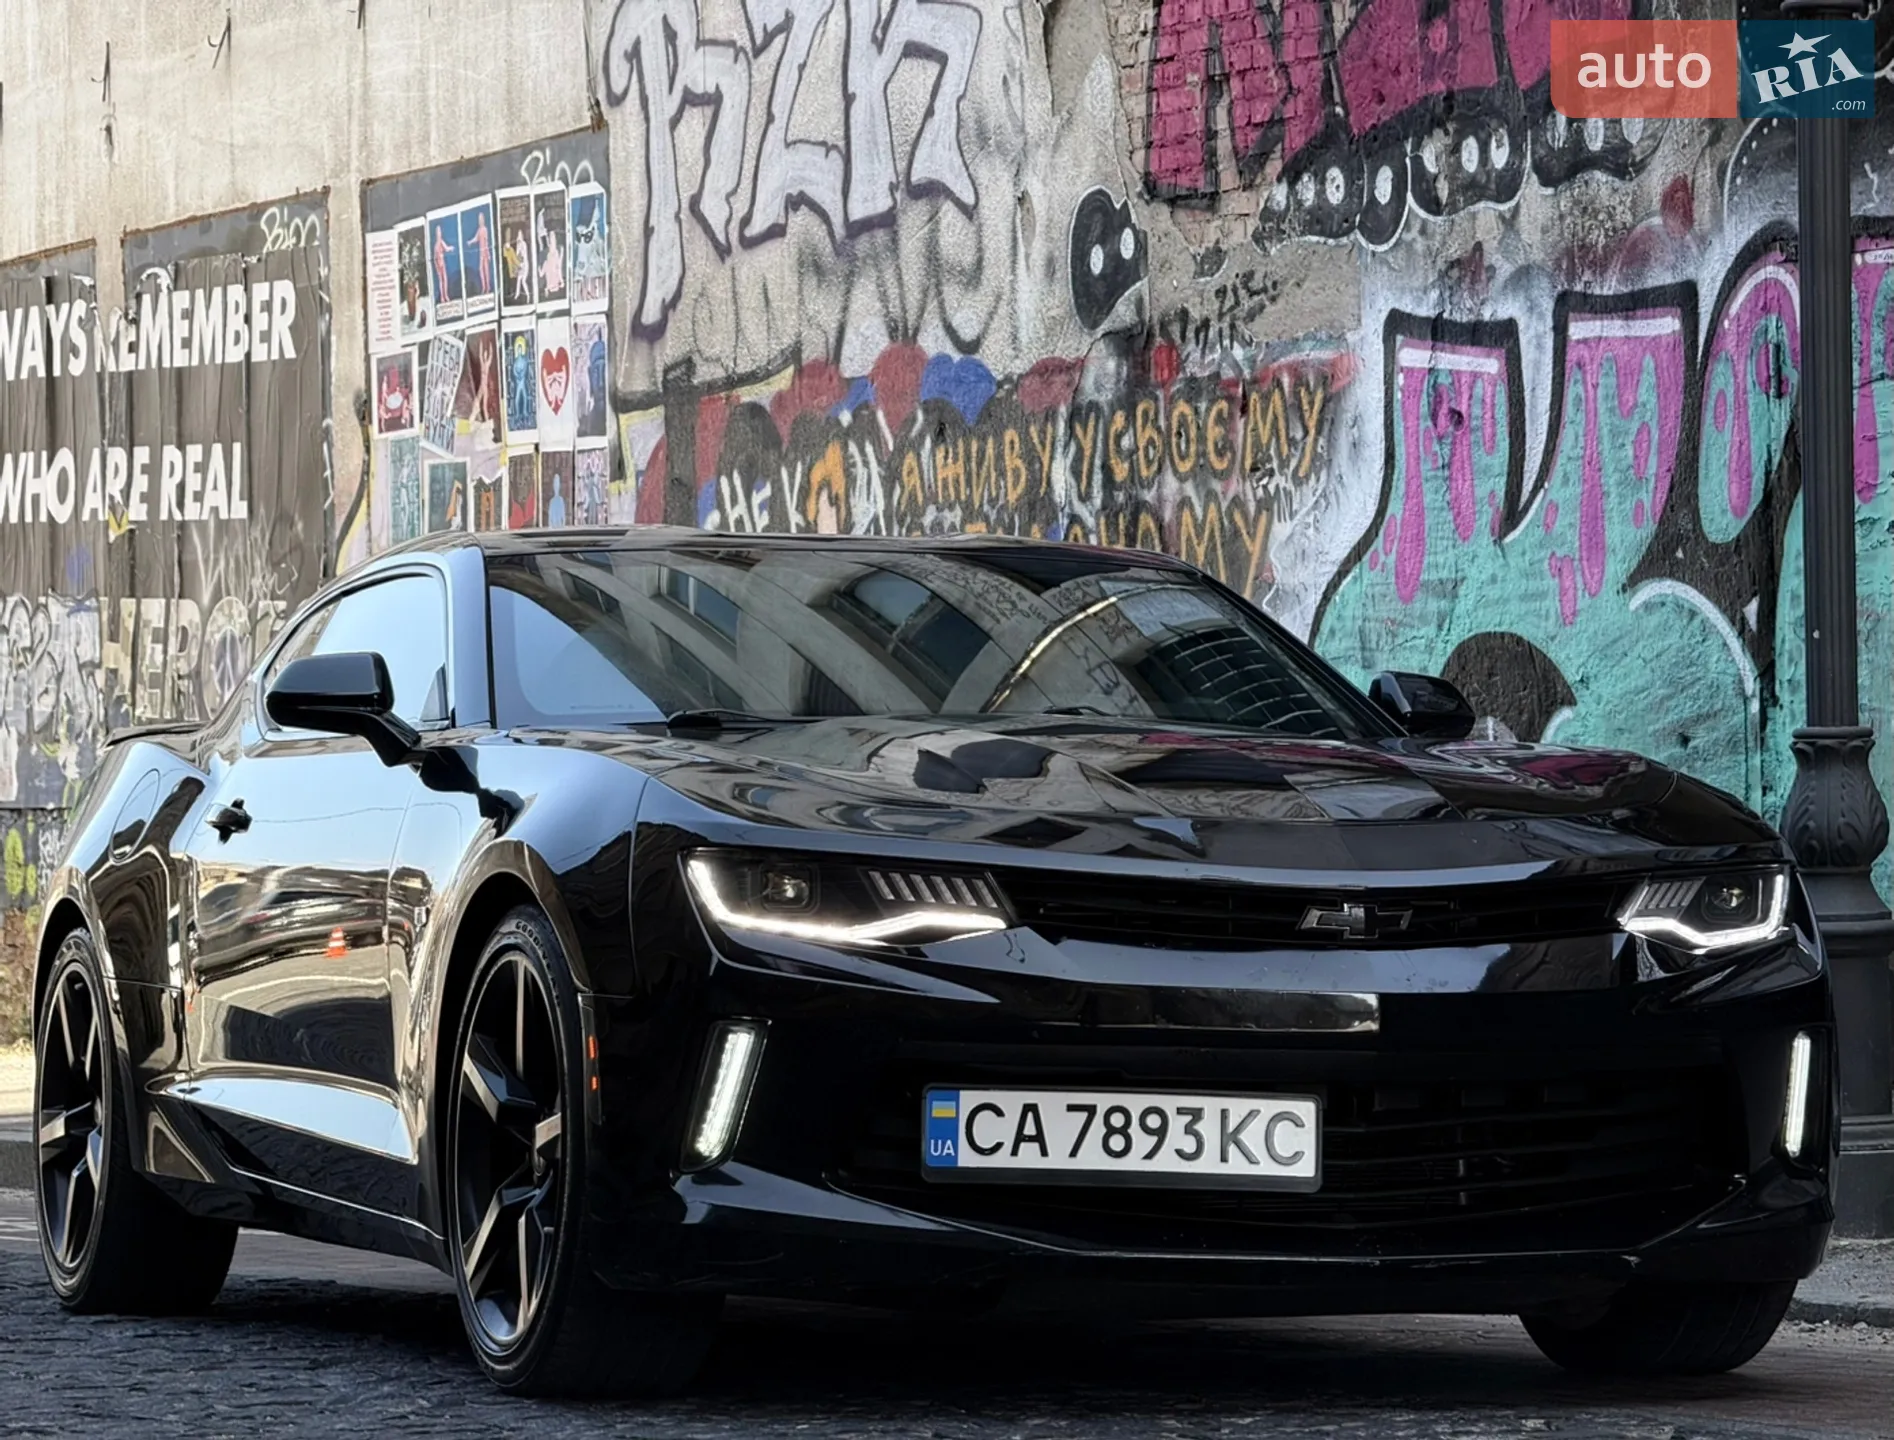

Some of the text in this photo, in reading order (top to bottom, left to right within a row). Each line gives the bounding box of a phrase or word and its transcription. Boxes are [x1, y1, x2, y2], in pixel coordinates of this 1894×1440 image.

[94, 279, 297, 372] REMEMBER
[0, 442, 248, 524] WHO ARE REAL
[930, 1139, 956, 1157] UA
[964, 1102, 1307, 1166] CA 7893 KC
